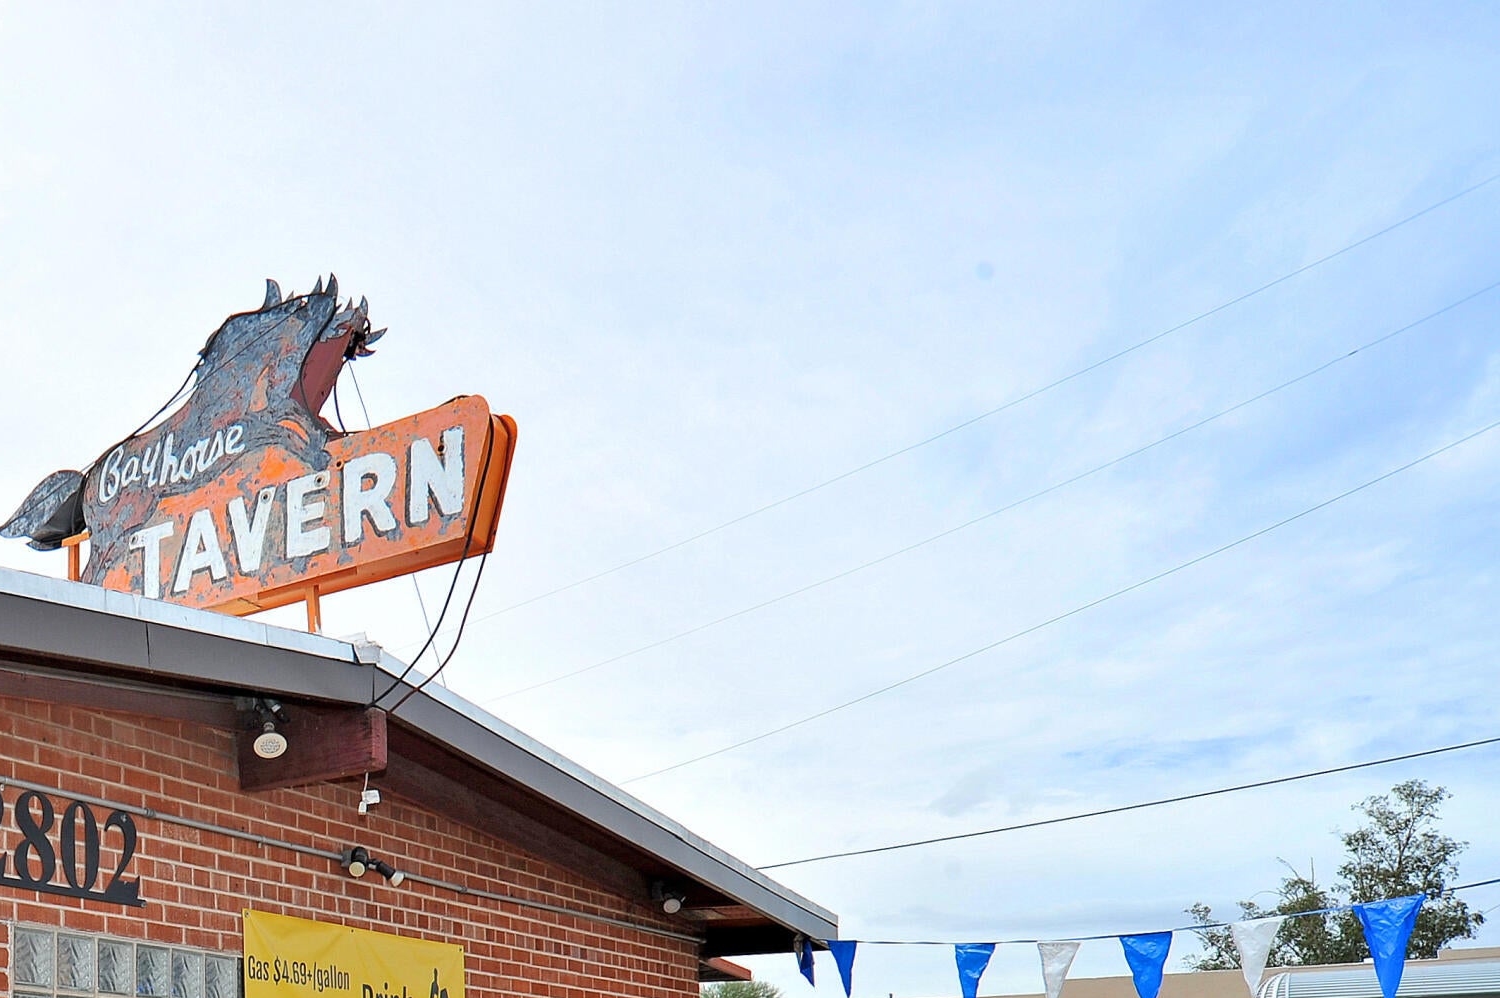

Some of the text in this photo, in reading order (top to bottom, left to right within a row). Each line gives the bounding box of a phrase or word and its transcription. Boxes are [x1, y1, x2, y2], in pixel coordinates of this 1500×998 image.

[98, 422, 247, 505] Bayhorse
[130, 426, 466, 600] TAVERN
[247, 955, 350, 992] Gas $4.69+/gallon
